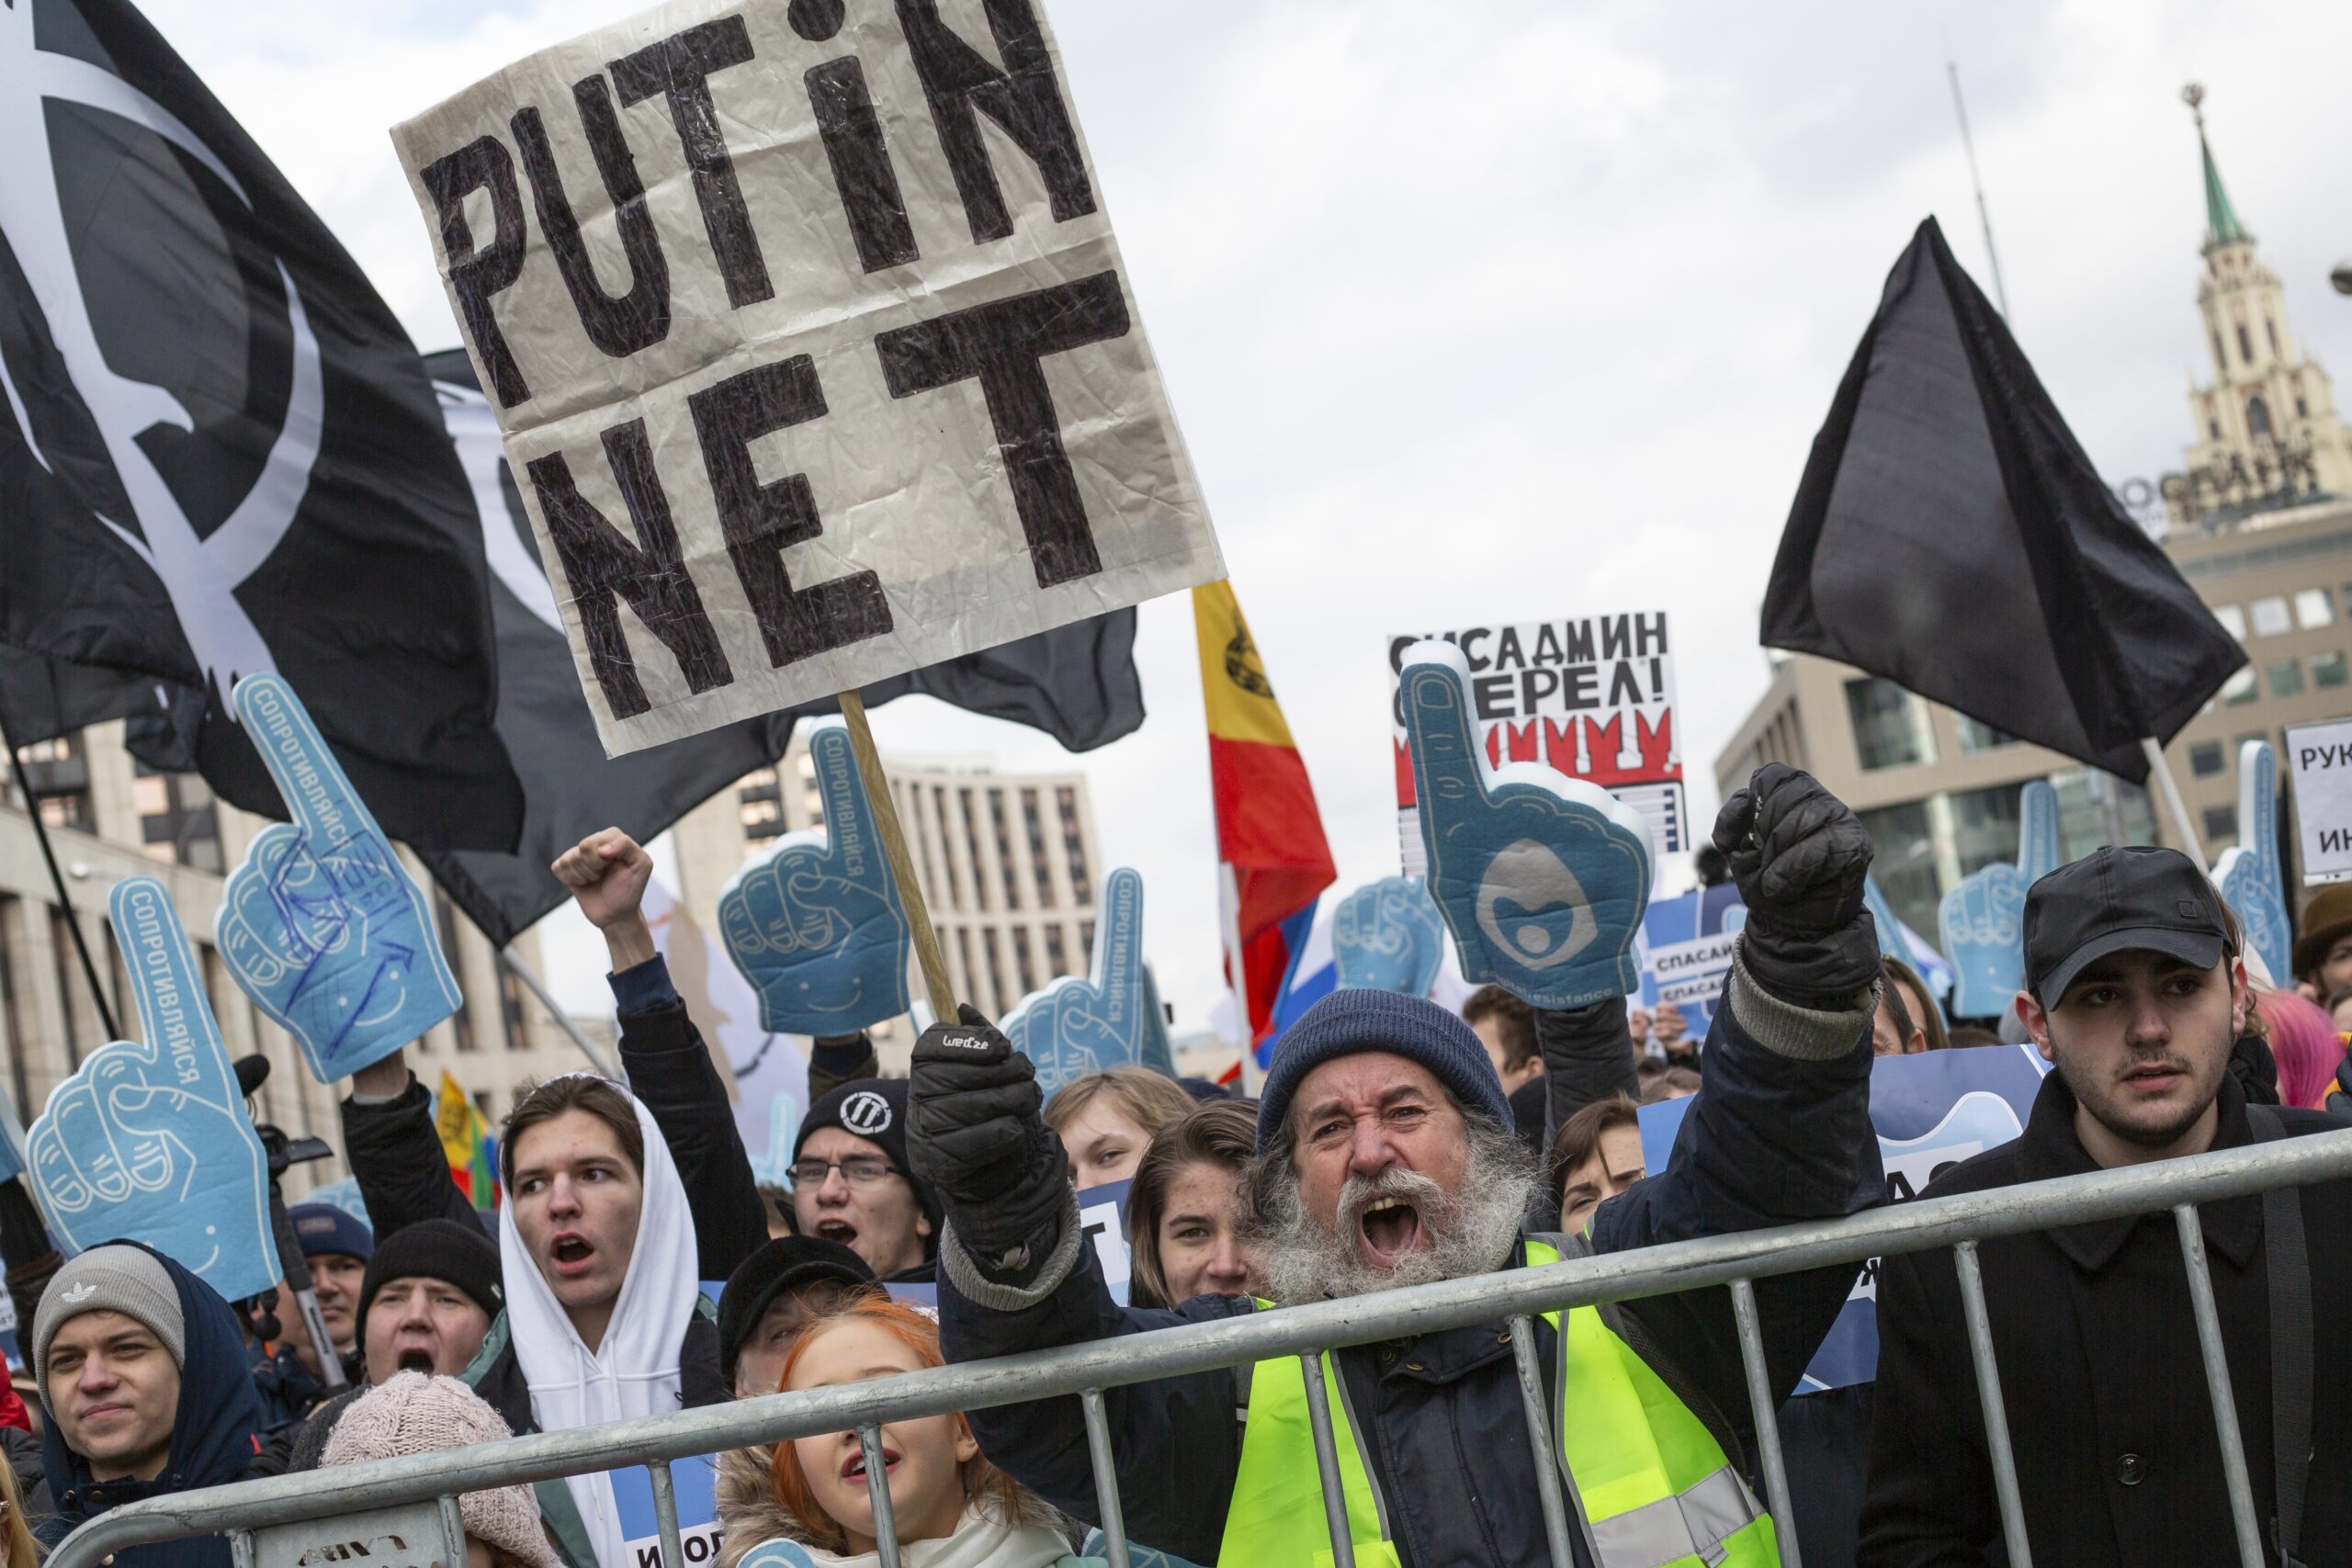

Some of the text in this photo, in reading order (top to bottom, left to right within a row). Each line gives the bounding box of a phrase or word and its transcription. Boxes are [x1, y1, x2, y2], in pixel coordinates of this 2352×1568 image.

[526, 270, 1130, 720] NET
[1389, 612, 1668, 678] ССАДМИН
[254, 688, 354, 852] СОПРОТИВЛЯЙСЯ
[824, 735, 865, 877] СОПРОТИВЛЯЙСЯ
[130, 891, 200, 1085] СОПРОТИВЛЯЙСЯ
[1108, 877, 1134, 1022] СОПРОТИВЛЯЙСЯ
